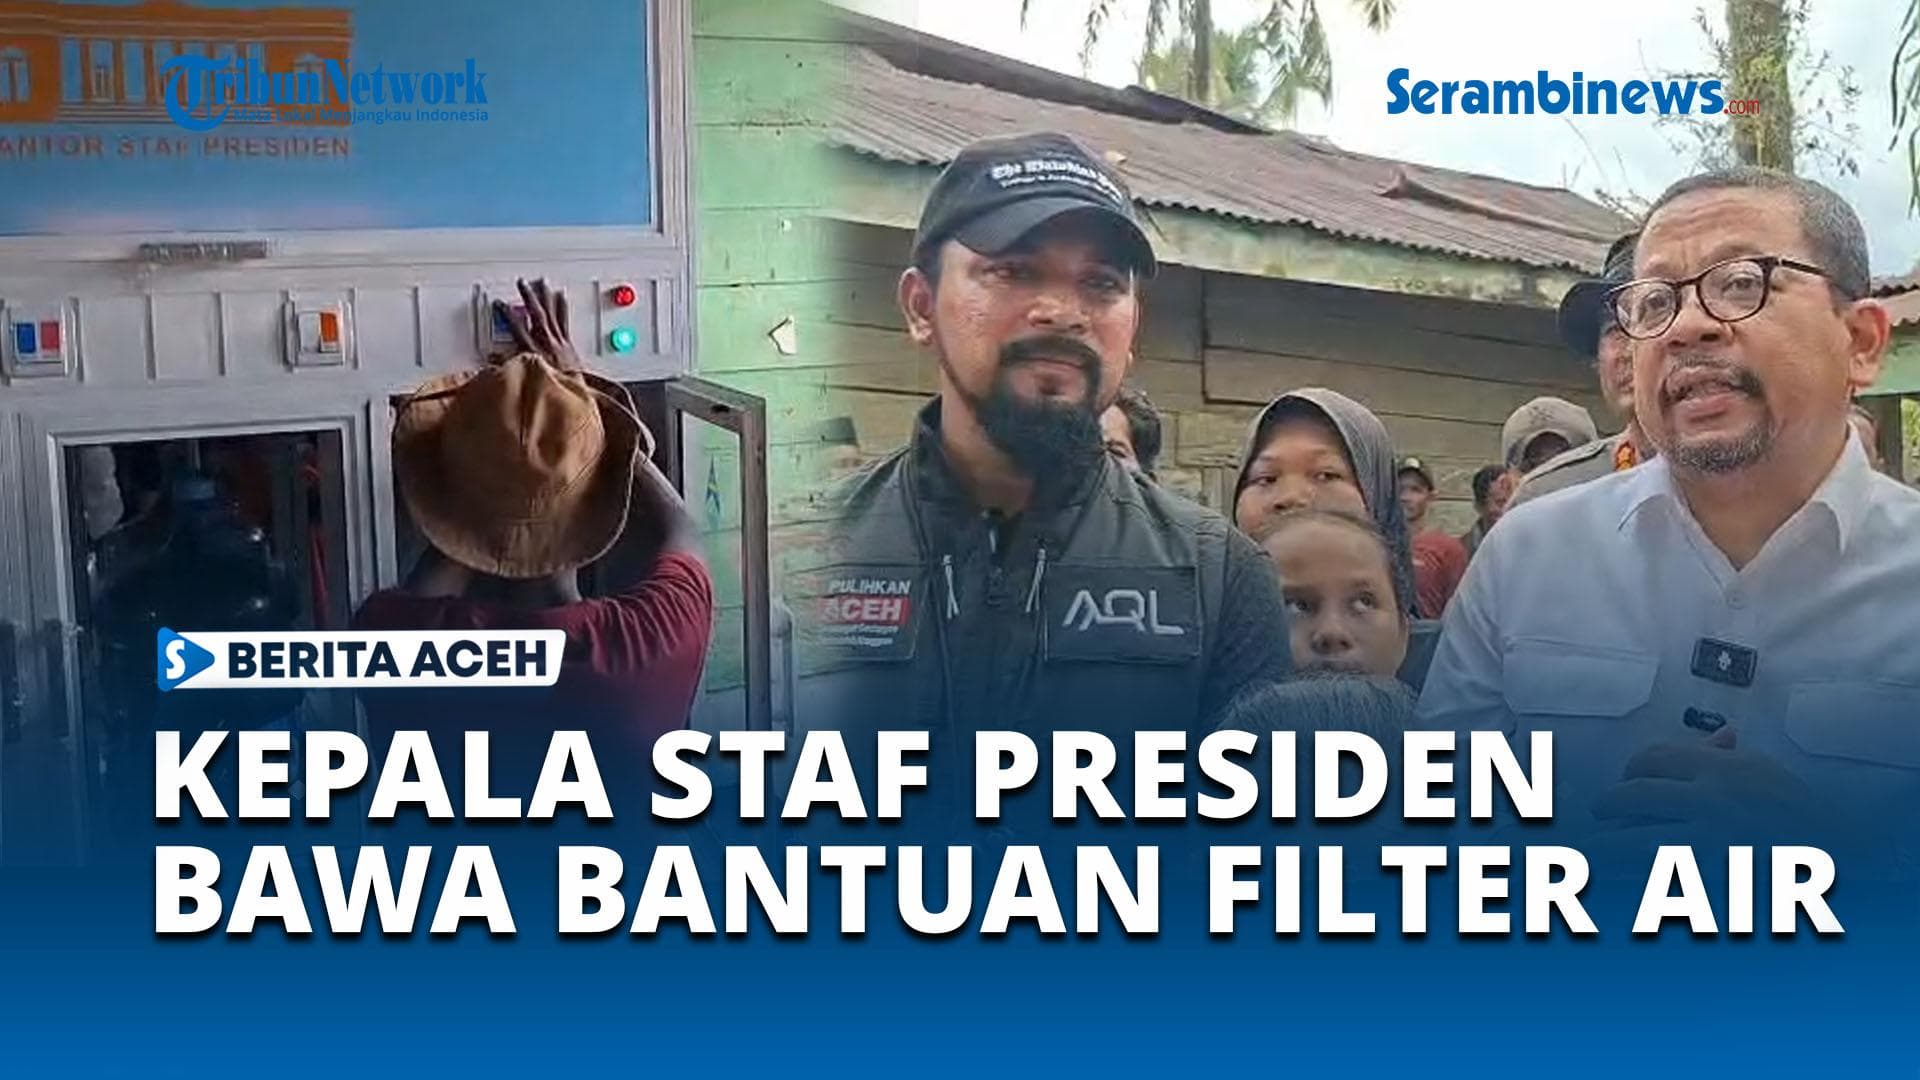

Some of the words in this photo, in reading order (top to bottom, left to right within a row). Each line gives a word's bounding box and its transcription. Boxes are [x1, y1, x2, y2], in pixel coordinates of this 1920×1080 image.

[203, 136, 350, 158] PRESIDEN
[829, 578, 911, 594] PULIHKAN
[821, 597, 903, 621] ACEH
[1063, 589, 1184, 634] AQL
